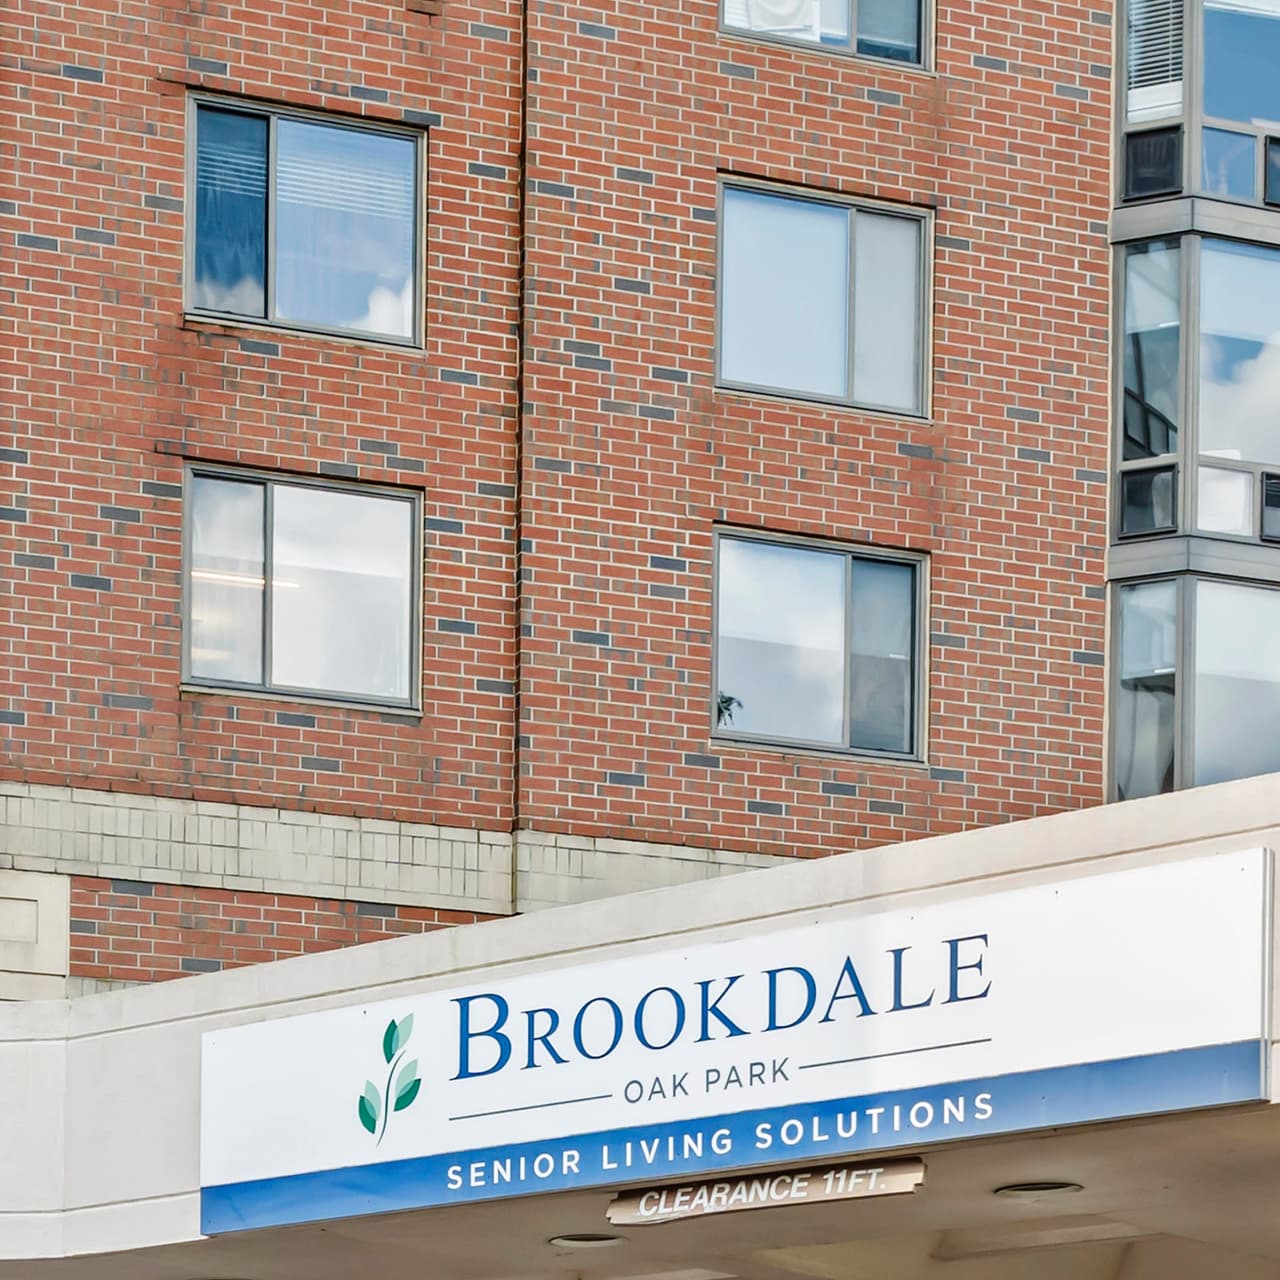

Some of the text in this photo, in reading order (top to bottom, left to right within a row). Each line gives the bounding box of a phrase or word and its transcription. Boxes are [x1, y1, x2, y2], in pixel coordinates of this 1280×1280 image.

[449, 933, 992, 1081] BROOKDALE
[624, 1057, 789, 1103] OAK PARK
[447, 1093, 993, 1190] SENIOR LIVING SOLUTIONS
[638, 1173, 811, 1217] CLEARANCE
